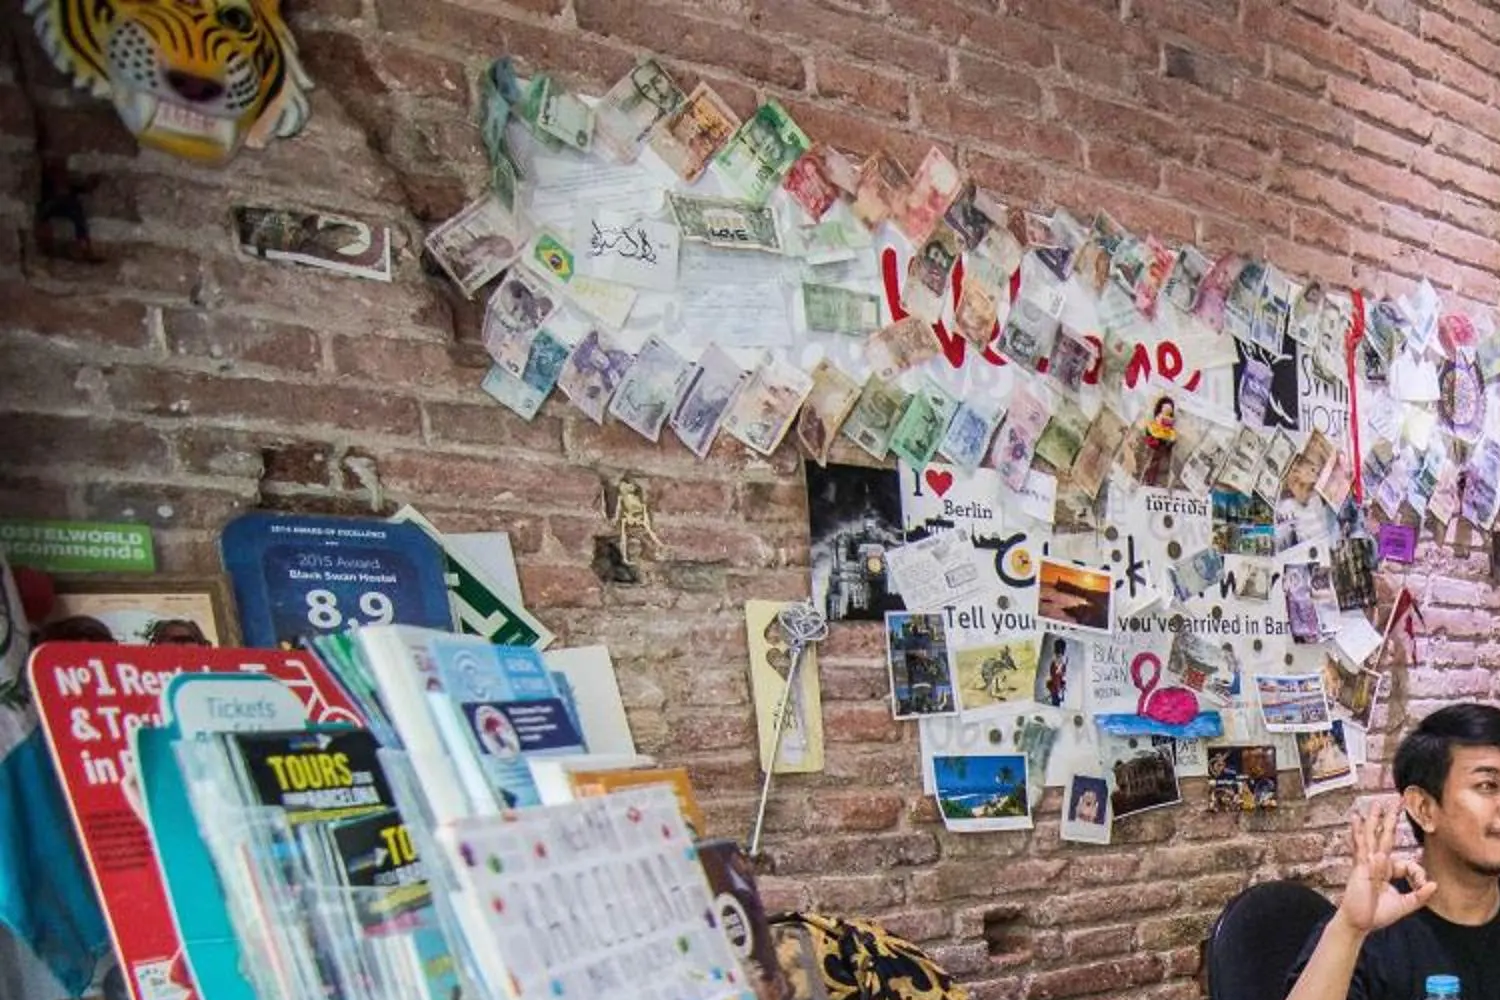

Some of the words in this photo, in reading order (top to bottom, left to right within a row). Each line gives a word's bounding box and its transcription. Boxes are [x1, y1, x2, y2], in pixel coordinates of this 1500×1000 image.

[943, 499, 993, 519] Berlin
[0, 525, 143, 545] OSTELWORLD
[336, 555, 381, 569] Award
[289, 569, 322, 580] Black
[324, 571, 357, 582] Swan
[359, 573, 397, 583] Hostel
[943, 605, 985, 629] Tell
[1246, 616, 1260, 635] in
[206, 696, 277, 719] Tickets
[81, 749, 119, 784] in
[267, 752, 353, 791] TOURS
